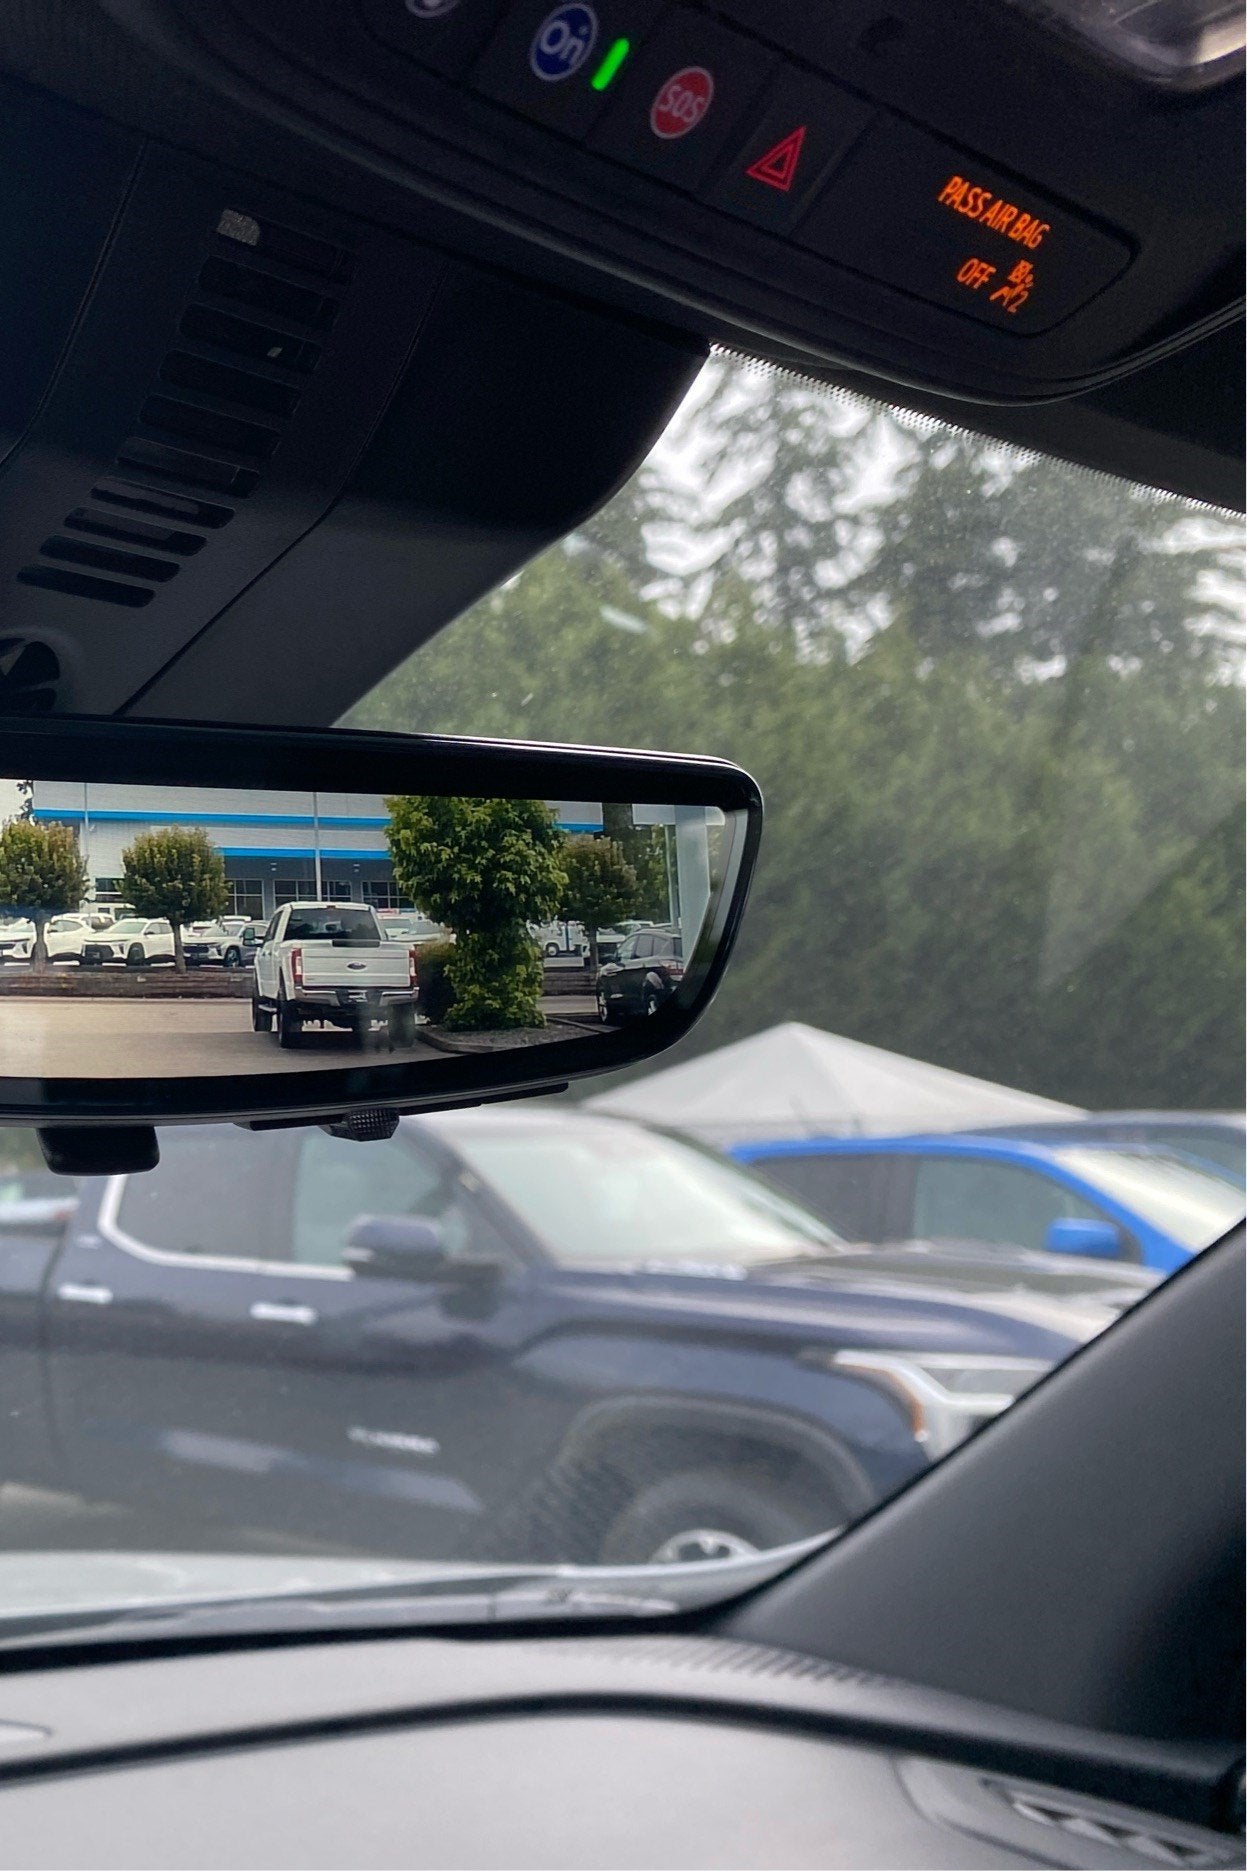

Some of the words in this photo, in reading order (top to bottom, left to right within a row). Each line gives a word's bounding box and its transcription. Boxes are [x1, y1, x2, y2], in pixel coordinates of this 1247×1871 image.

[540, 20, 585, 66] On
[657, 85, 706, 122] SOS
[937, 175, 992, 218] PASS
[979, 200, 1018, 233] AIR
[1007, 213, 1051, 249] BAG
[957, 258, 997, 289] OFF
